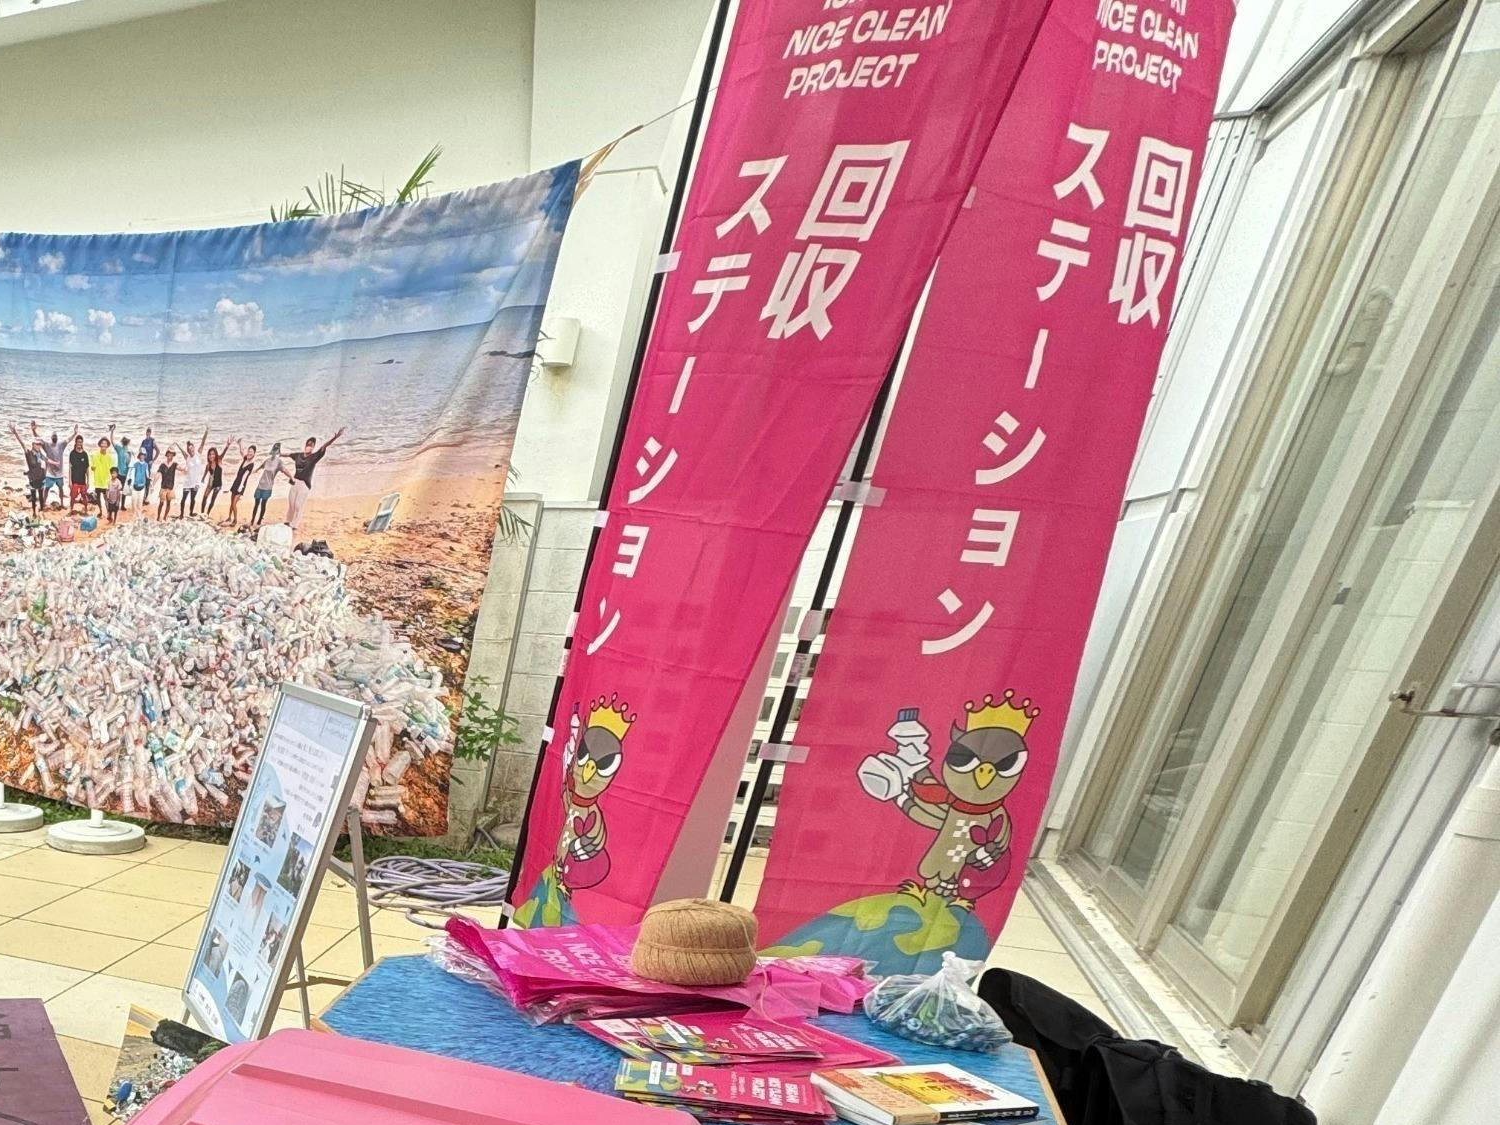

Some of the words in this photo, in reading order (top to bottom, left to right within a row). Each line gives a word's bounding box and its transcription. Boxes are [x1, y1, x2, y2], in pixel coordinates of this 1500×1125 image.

[782, 15, 853, 59] NICE
[852, 1, 953, 43] CLEAN
[783, 53, 919, 99] PROJECT
[1092, 40, 1182, 94] PROJECT
[1140, 9, 1199, 59] CLEAN
[759, 139, 912, 342] 回収
[1109, 136, 1193, 328] 回収
[586, 154, 790, 656] ステーション
[921, 121, 1110, 655] ステーション
